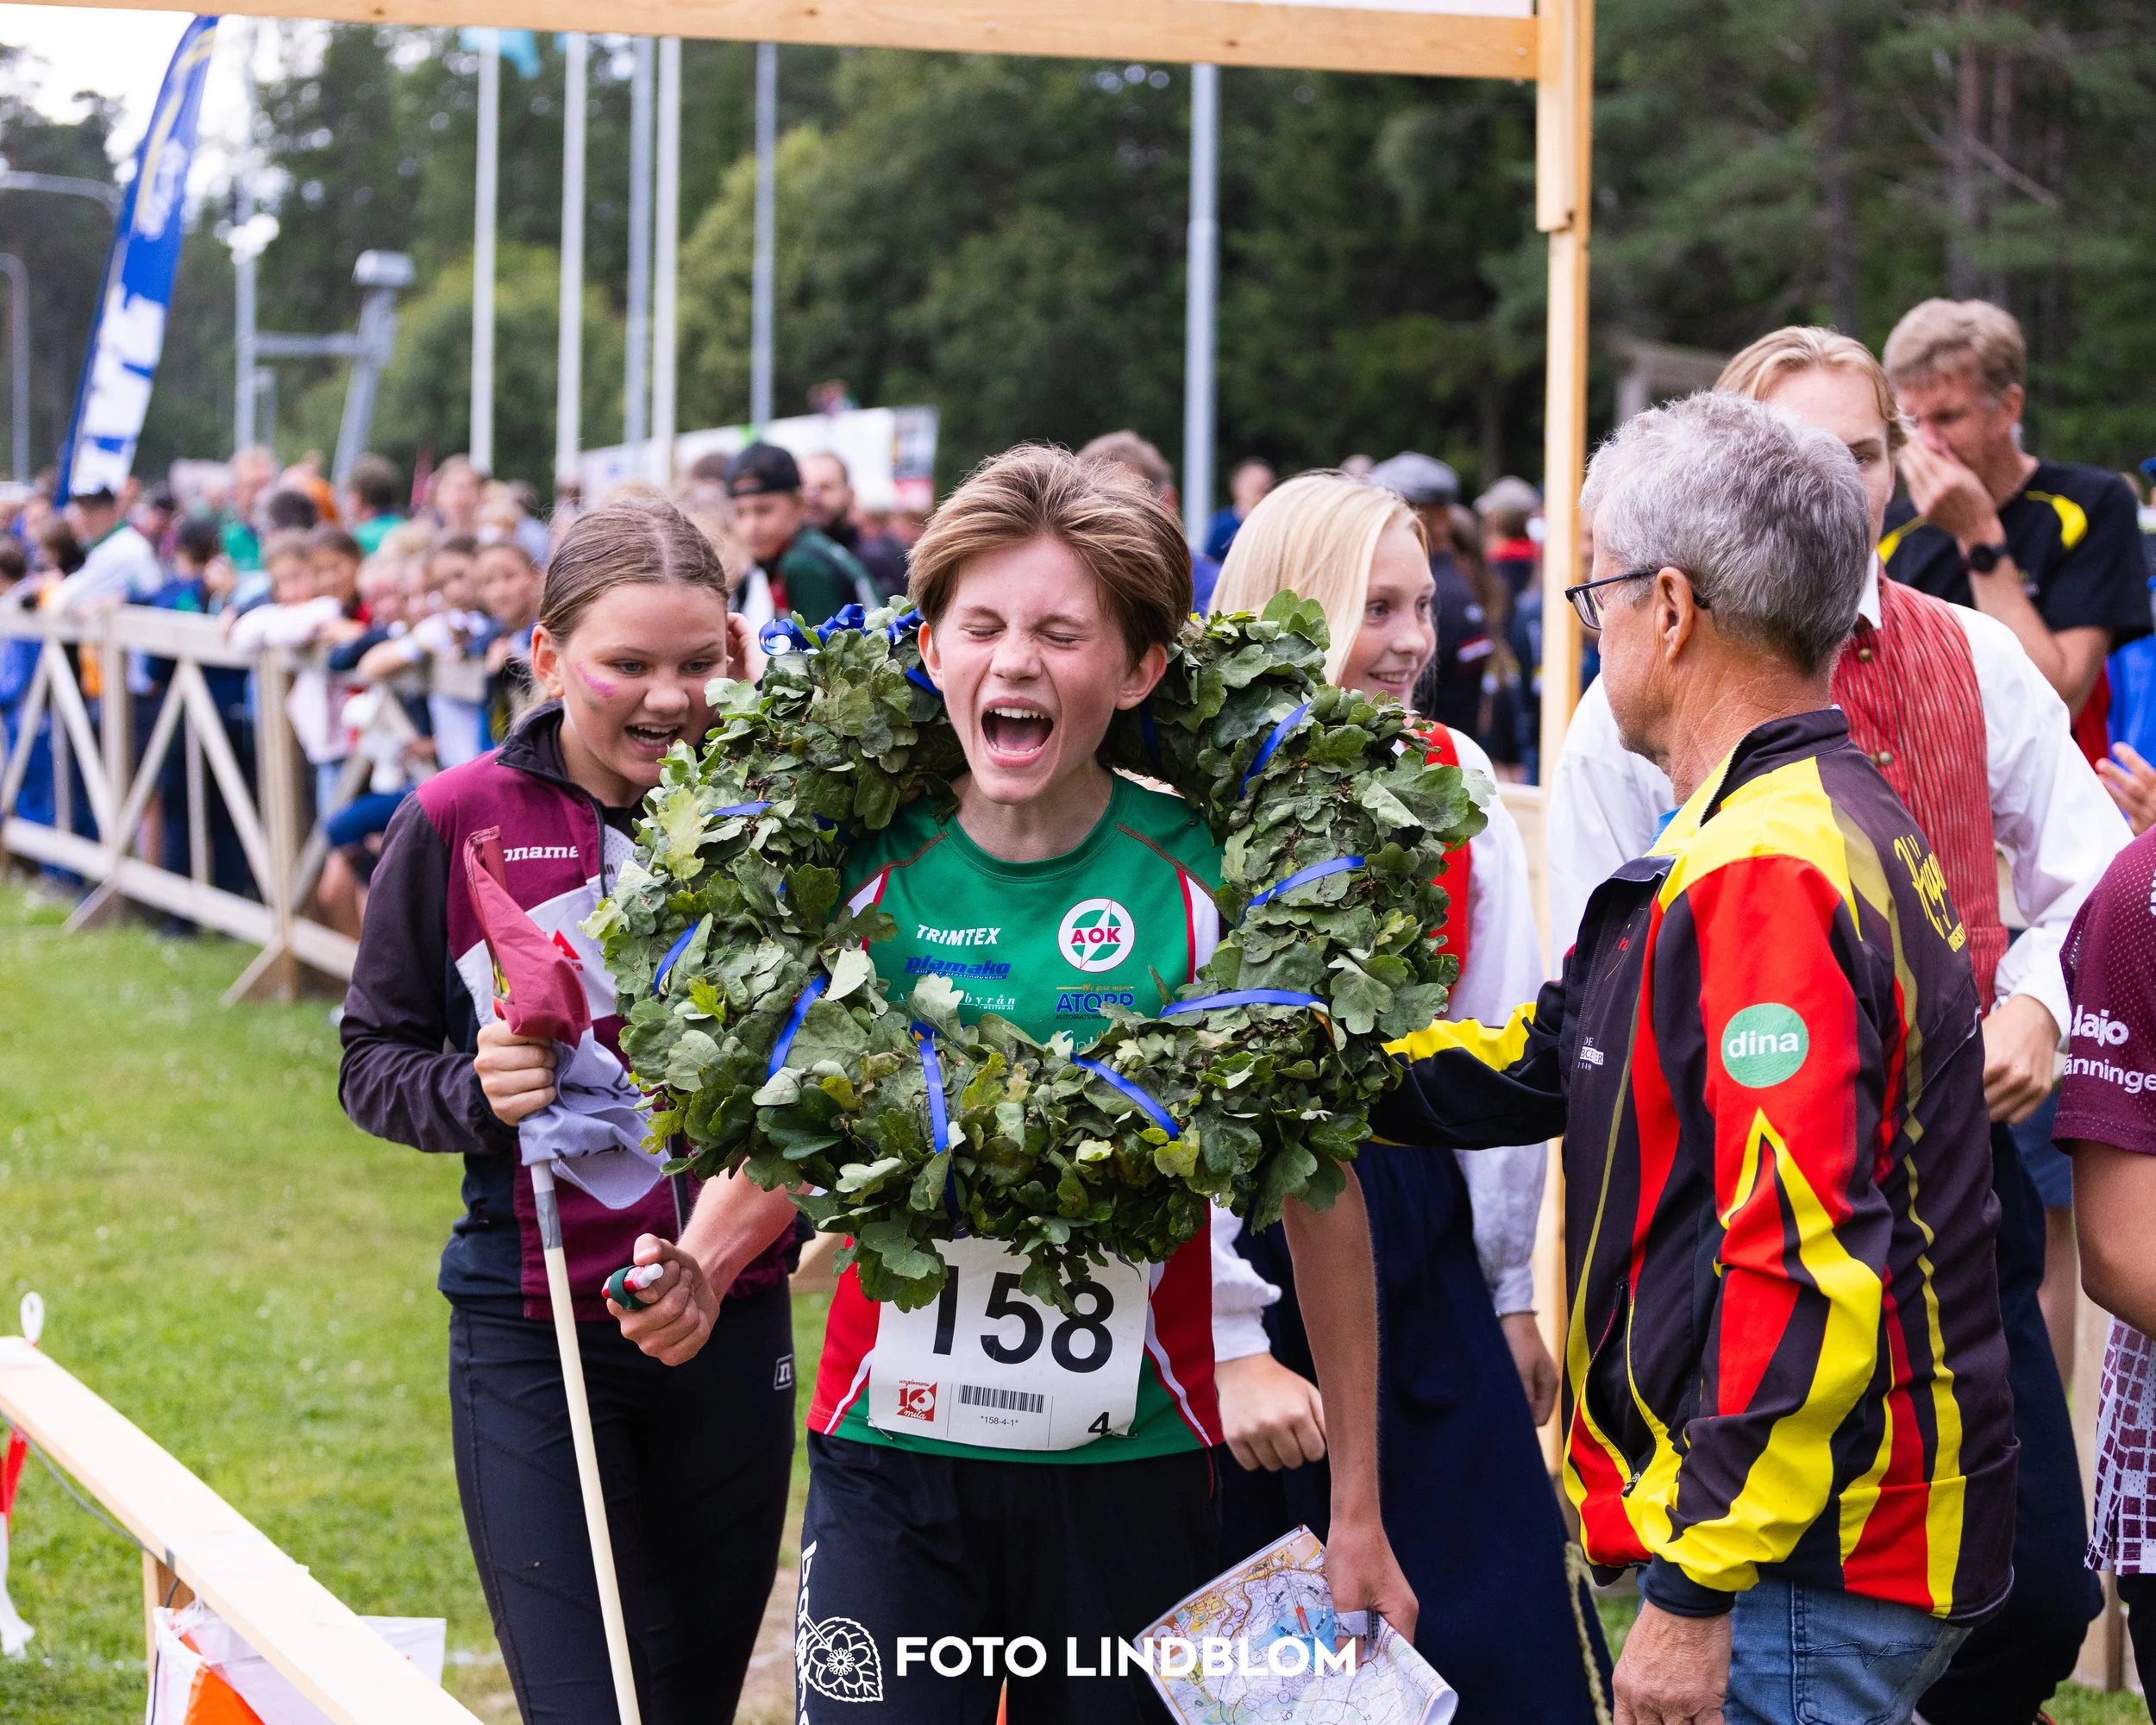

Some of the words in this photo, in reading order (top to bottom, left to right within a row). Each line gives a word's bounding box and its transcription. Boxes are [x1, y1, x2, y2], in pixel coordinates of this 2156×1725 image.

[916, 924, 1001, 946] TRIMTEX
[1070, 927, 1121, 944] AOK
[904, 954, 1012, 975] plamako
[1727, 1030, 1799, 1058] dina
[932, 1265, 1115, 1373] 158
[1087, 1411, 1112, 1435] 4
